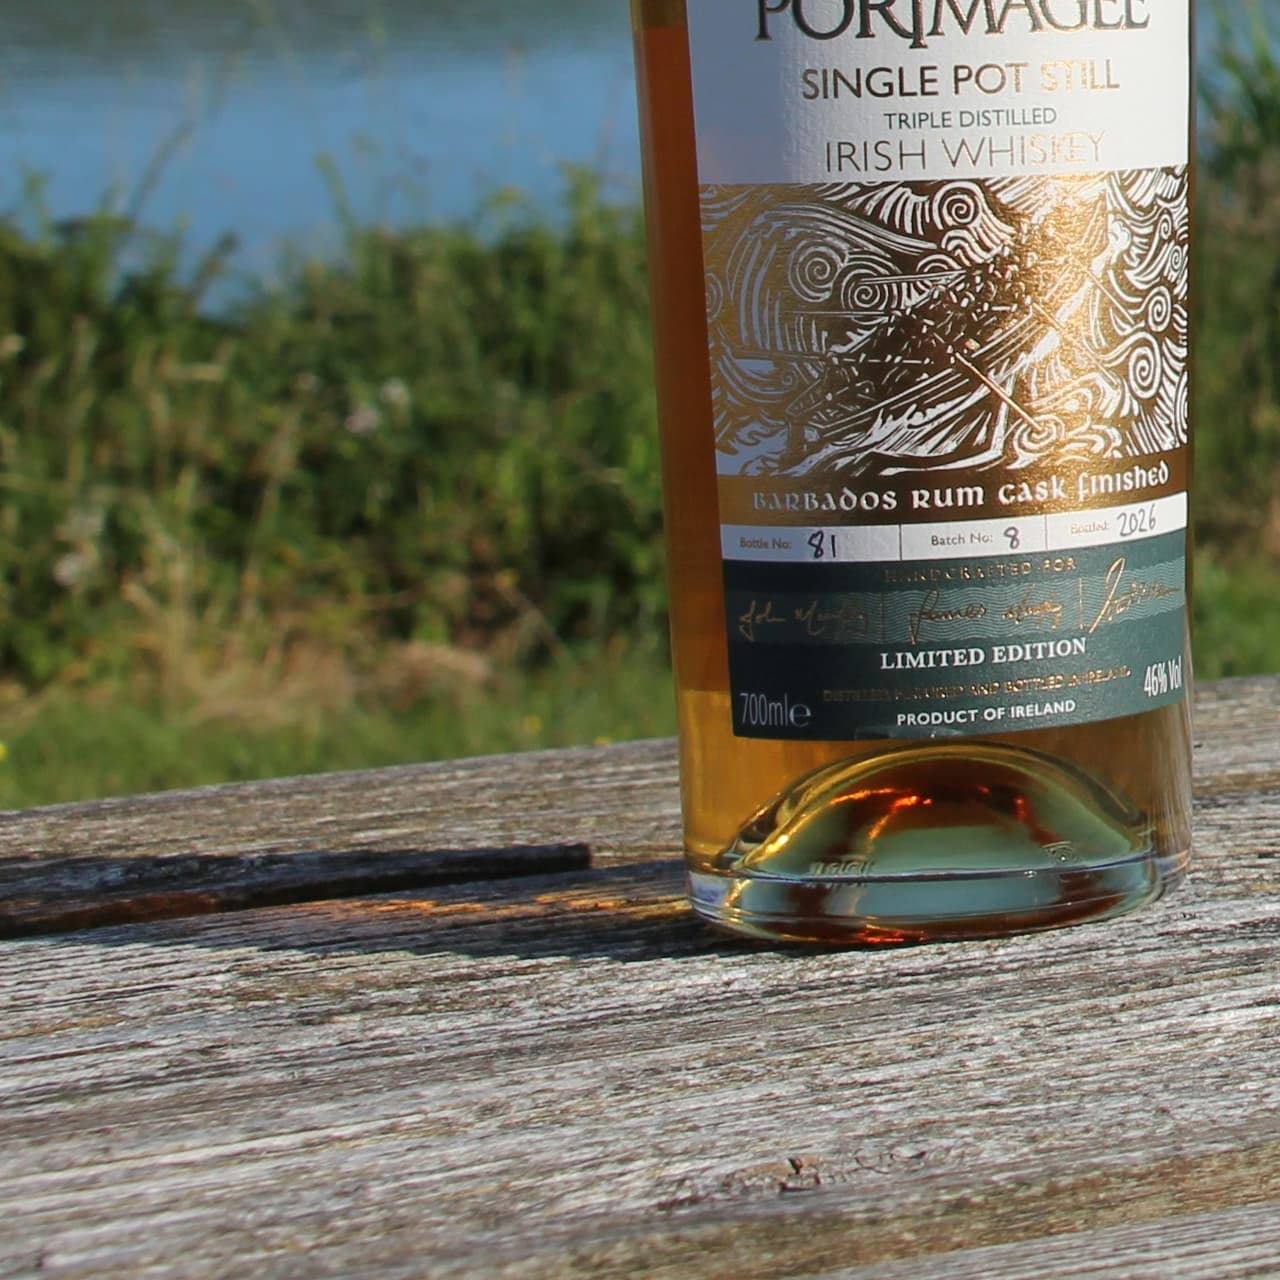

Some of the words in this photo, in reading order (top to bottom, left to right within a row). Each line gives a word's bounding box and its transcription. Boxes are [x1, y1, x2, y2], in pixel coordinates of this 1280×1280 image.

[801, 63, 940, 100] SINGLE
[952, 61, 1030, 95] POT
[1039, 58, 1121, 92] STILL
[883, 110, 953, 131] TRIPLE
[958, 106, 1058, 129] DISTILLED
[825, 138, 927, 174] IRISH
[940, 130, 1106, 171] WHISKEY
[1116, 503, 1158, 537] 2026
[739, 536, 769, 549] Bottle
[807, 529, 837, 559] 81
[931, 532, 966, 547] Batch
[969, 531, 994, 545] No:
[1003, 526, 1020, 550] 8
[880, 648, 986, 670] LIMITED
[991, 636, 1087, 663] EDITION
[1143, 664, 1168, 697] 46%
[1167, 655, 1183, 693] Vol
[897, 709, 977, 727] PRODUCT
[984, 707, 1006, 721] OF
[1010, 699, 1077, 720] IRELAND
